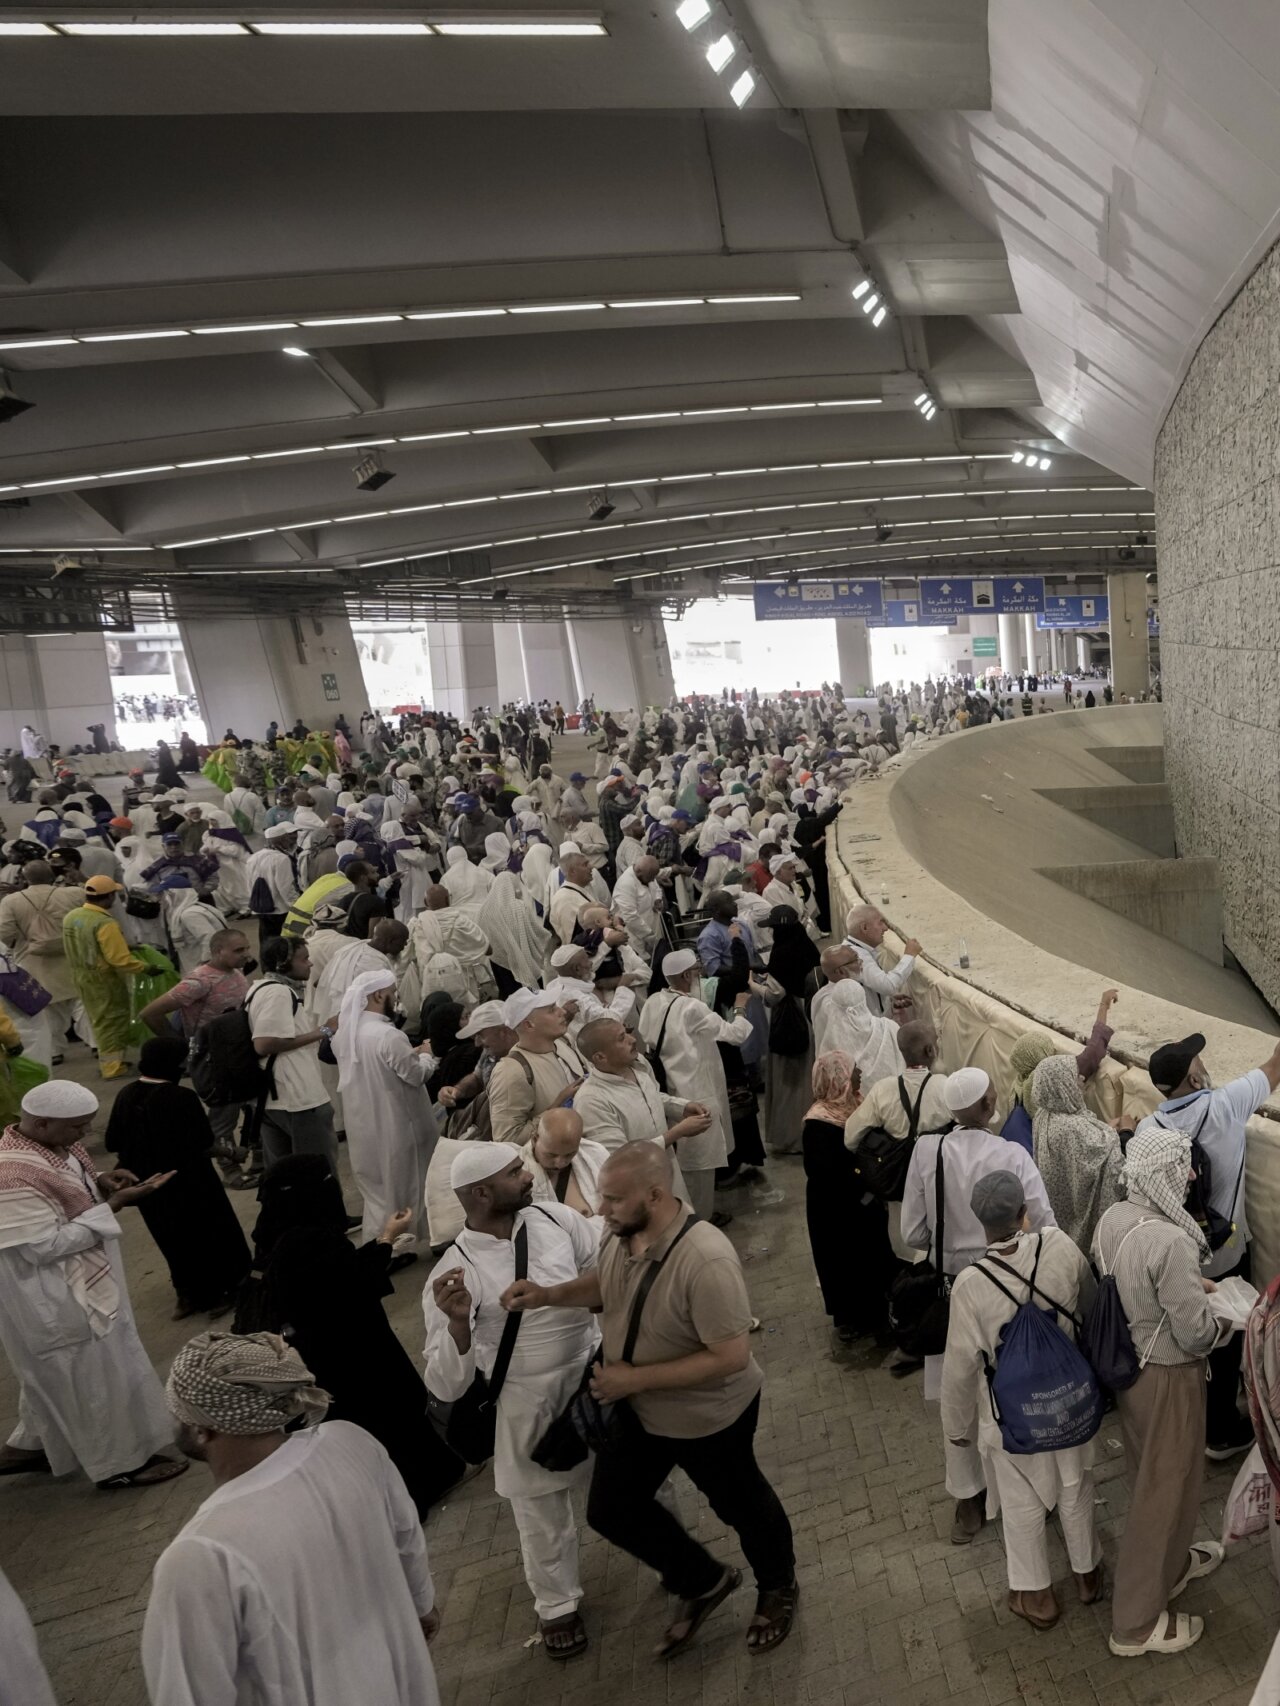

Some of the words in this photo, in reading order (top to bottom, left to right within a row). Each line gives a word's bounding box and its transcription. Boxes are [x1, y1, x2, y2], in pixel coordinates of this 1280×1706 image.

[928, 598, 952, 606] المكرمة
[1002, 595, 1025, 604] المكرمة
[1031, 1386, 1067, 1400] SPONSORED
